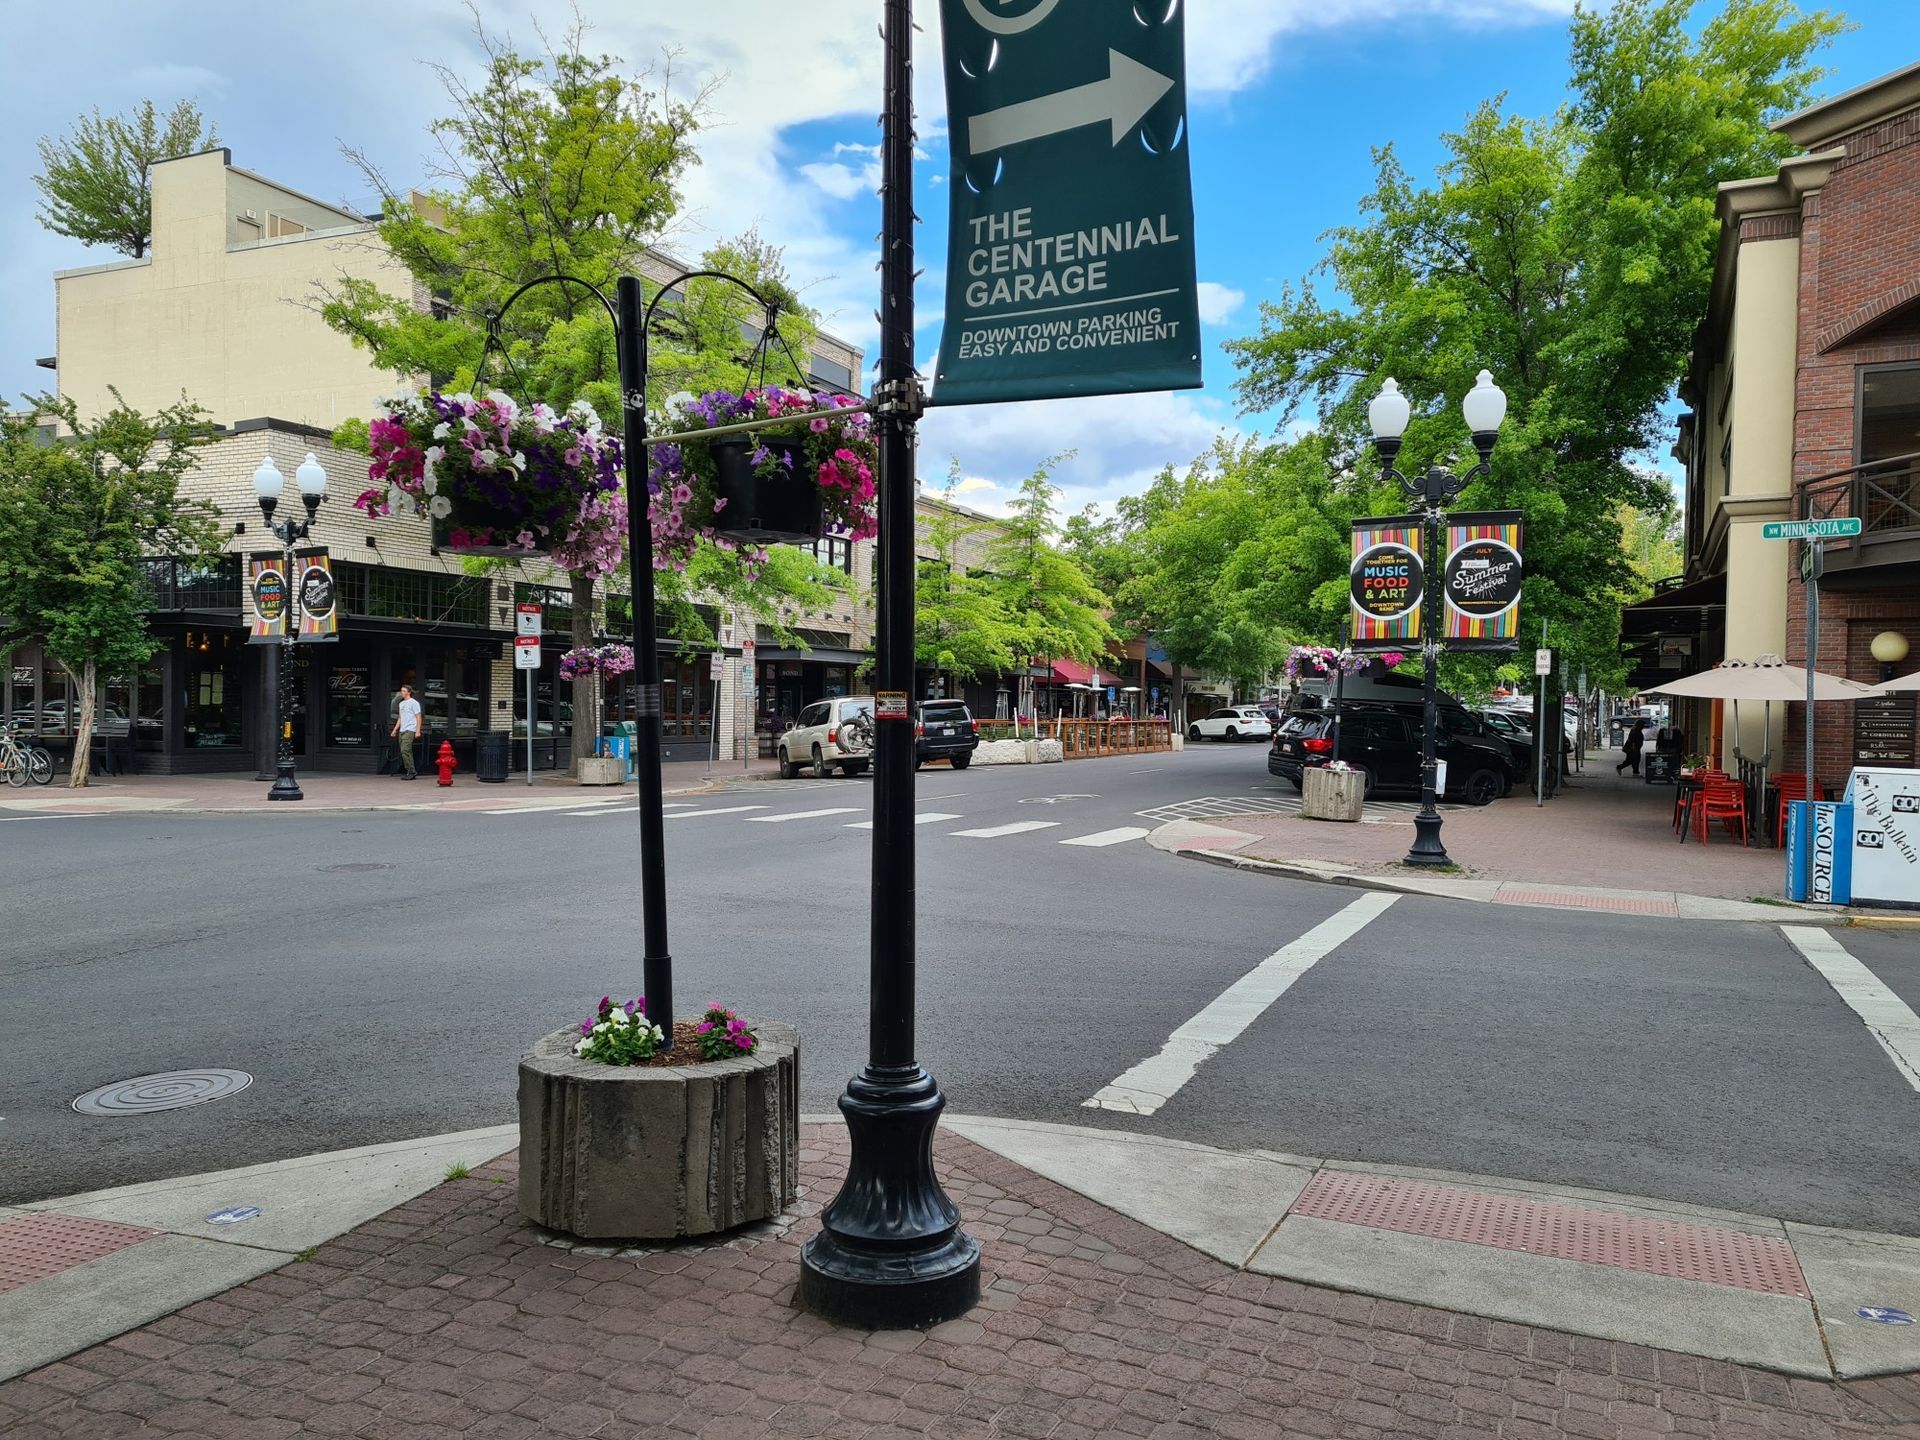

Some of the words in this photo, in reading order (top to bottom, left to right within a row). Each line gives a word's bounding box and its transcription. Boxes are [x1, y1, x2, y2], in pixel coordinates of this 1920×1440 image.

[970, 207, 1032, 244] THE
[968, 214, 1179, 276] CENTENNIAL
[966, 261, 1107, 307] GARAGE
[961, 320, 1071, 346] DOWNTOWN
[1077, 307, 1162, 333] PARKING
[959, 342, 1007, 359] EASY
[1011, 338, 1050, 355] AND
[1056, 321, 1180, 351] CONVENIENT
[1768, 527, 1778, 535] NW
[1780, 521, 1839, 537] MINNESOTA
[1841, 522, 1854, 531] AVE
[1363, 577, 1409, 588] FOOD
[1364, 565, 1409, 577] MUSIC
[1452, 562, 1514, 589] Summer
[260, 585, 280, 593] MUSIC
[1365, 589, 1374, 599] &
[1379, 588, 1407, 599] ART
[1462, 574, 1507, 597] Festival
[1893, 796, 1920, 810] GO!
[1857, 831, 1885, 845] GO!
[1862, 789, 1882, 818] The
[1878, 814, 1918, 865] Bulletin
